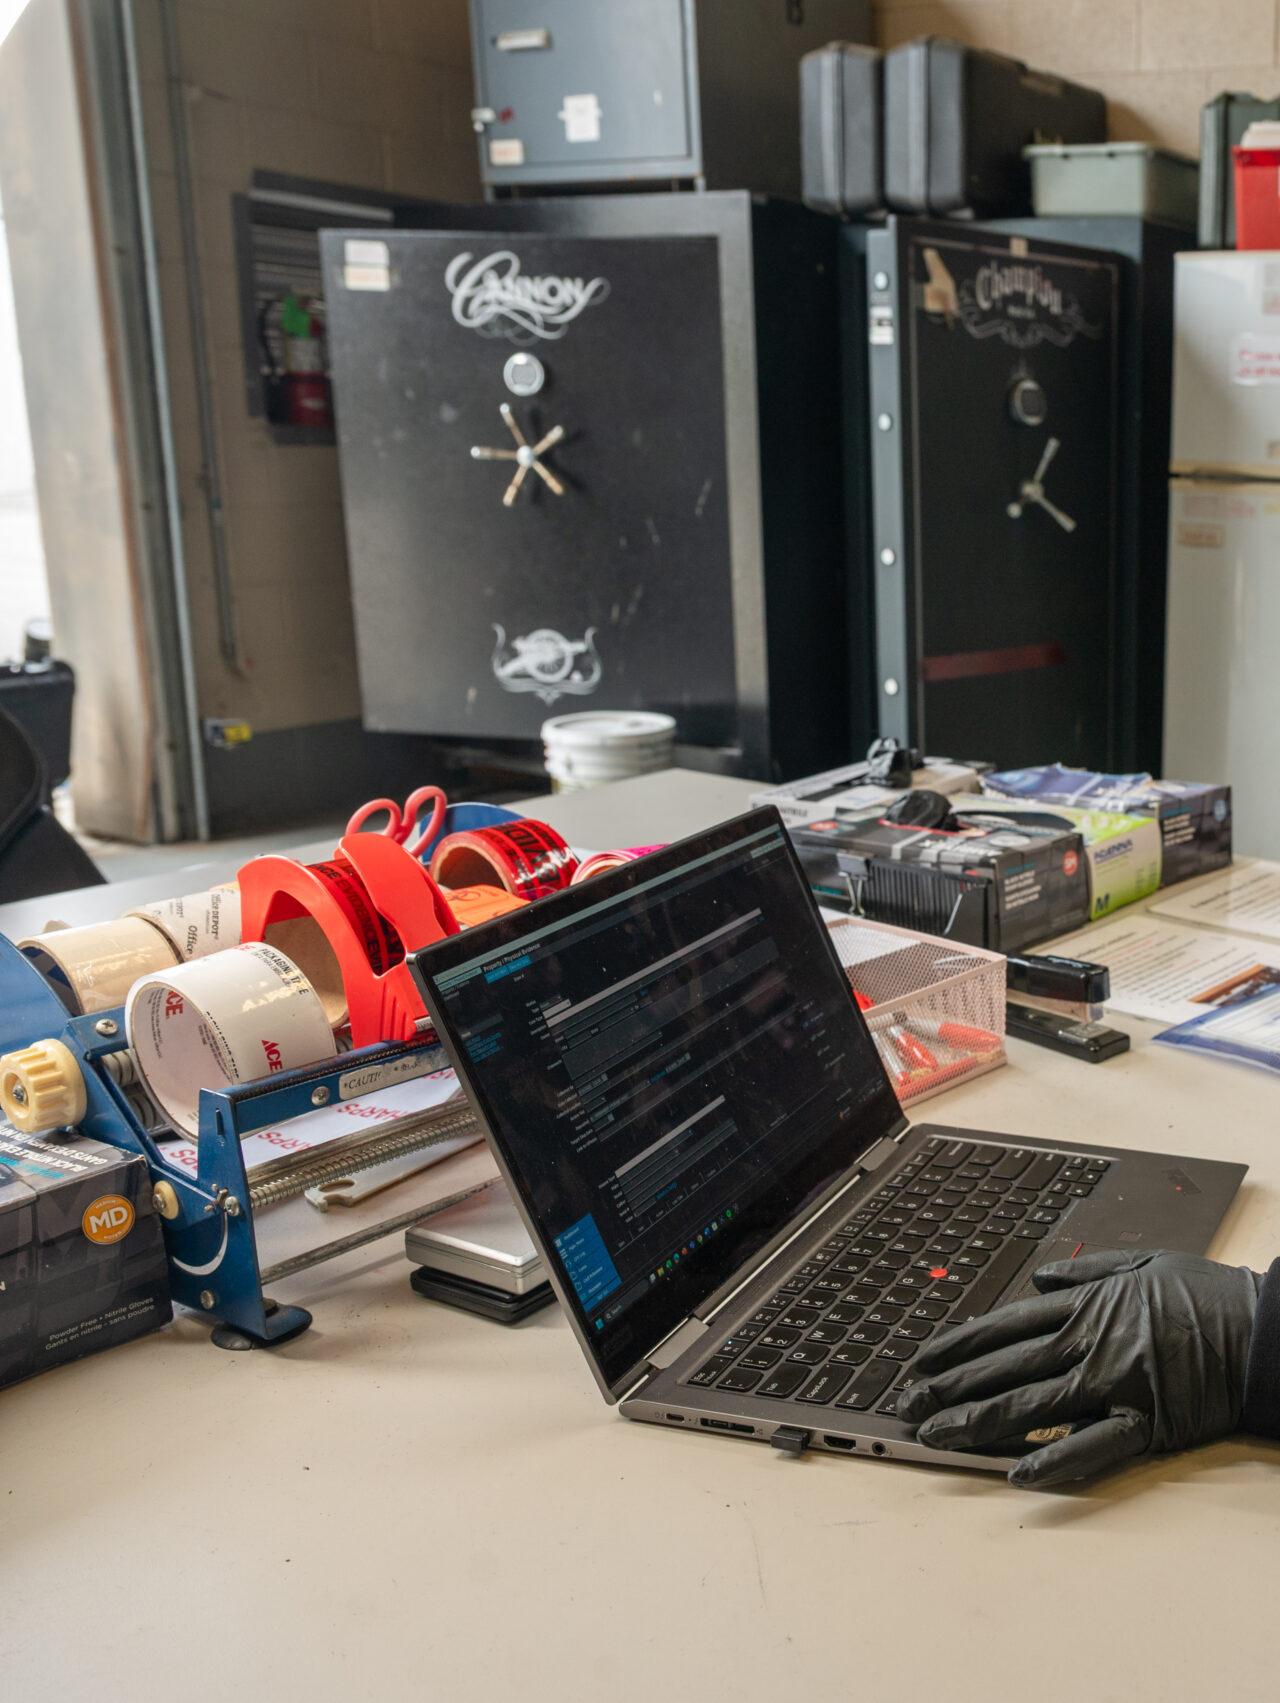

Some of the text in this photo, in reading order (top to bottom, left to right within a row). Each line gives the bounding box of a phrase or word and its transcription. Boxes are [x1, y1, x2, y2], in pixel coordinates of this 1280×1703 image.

[186, 925, 199, 955] Office
[521, 943, 541, 956] Evidence
[261, 1039, 283, 1074] ACE
[67, 1150, 109, 1166] GANTS
[89, 1207, 128, 1233] MD
[45, 1304, 155, 1350] Gants en nitrile sans poudre
[49, 1297, 154, 1340] Powder Free Nitrile Gloves
